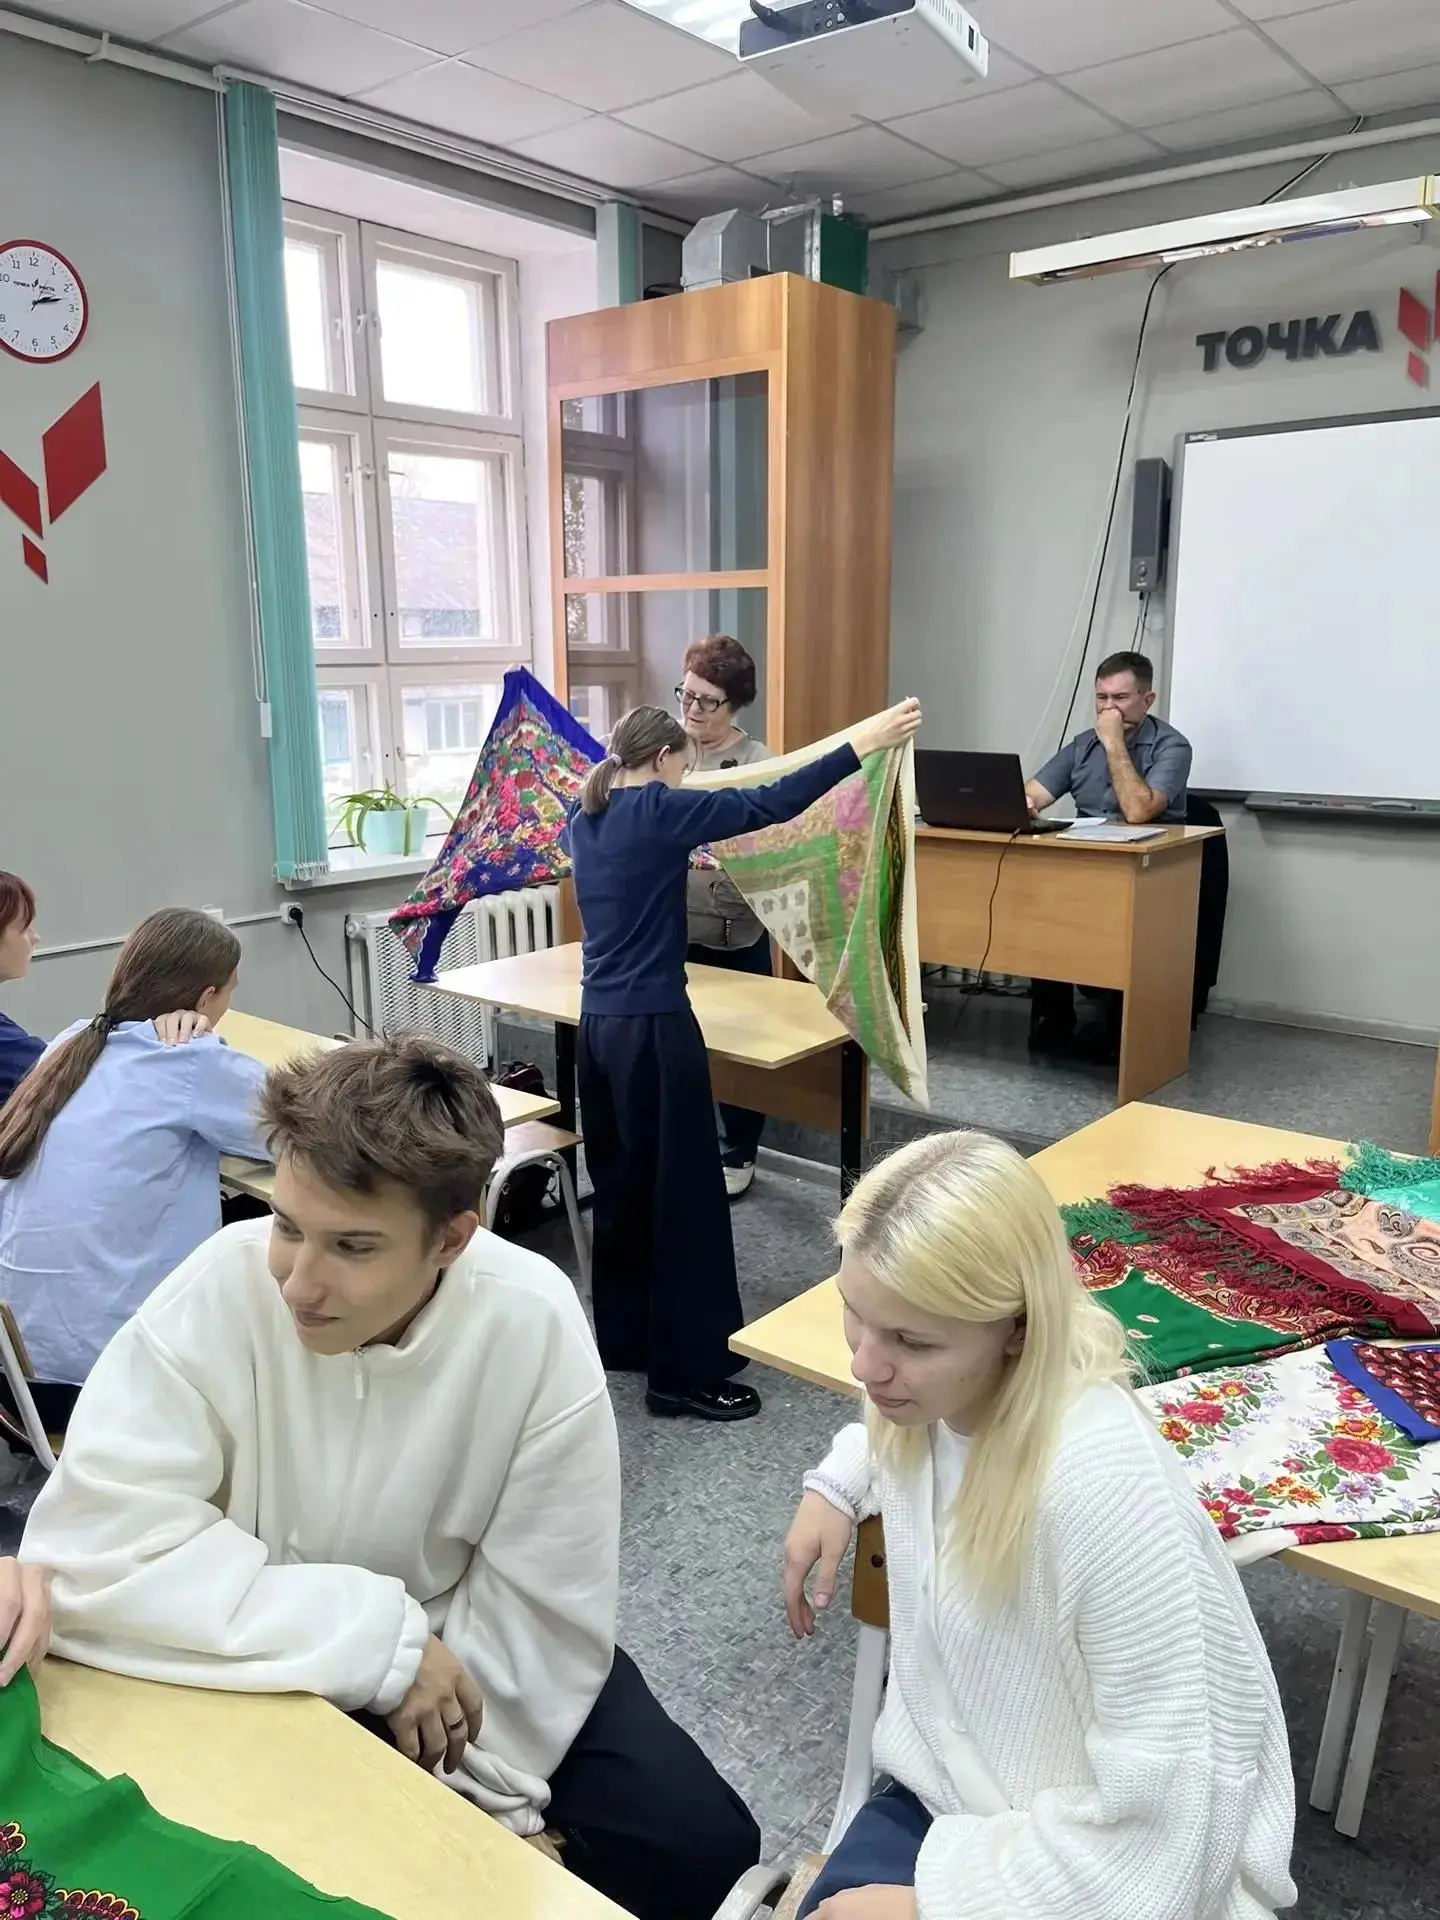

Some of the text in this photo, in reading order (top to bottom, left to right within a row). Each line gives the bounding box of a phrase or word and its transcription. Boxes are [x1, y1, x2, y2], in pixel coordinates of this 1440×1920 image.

[12, 260, 20, 269] 11
[29, 257, 39, 267] 12
[52, 267, 55, 275] 1
[64, 284, 69, 292] 2
[69, 304, 74, 312] 3
[14, 330, 19, 339] 7
[51, 336, 56, 344] 5
[1196, 310, 1380, 372] ТОЧКА
